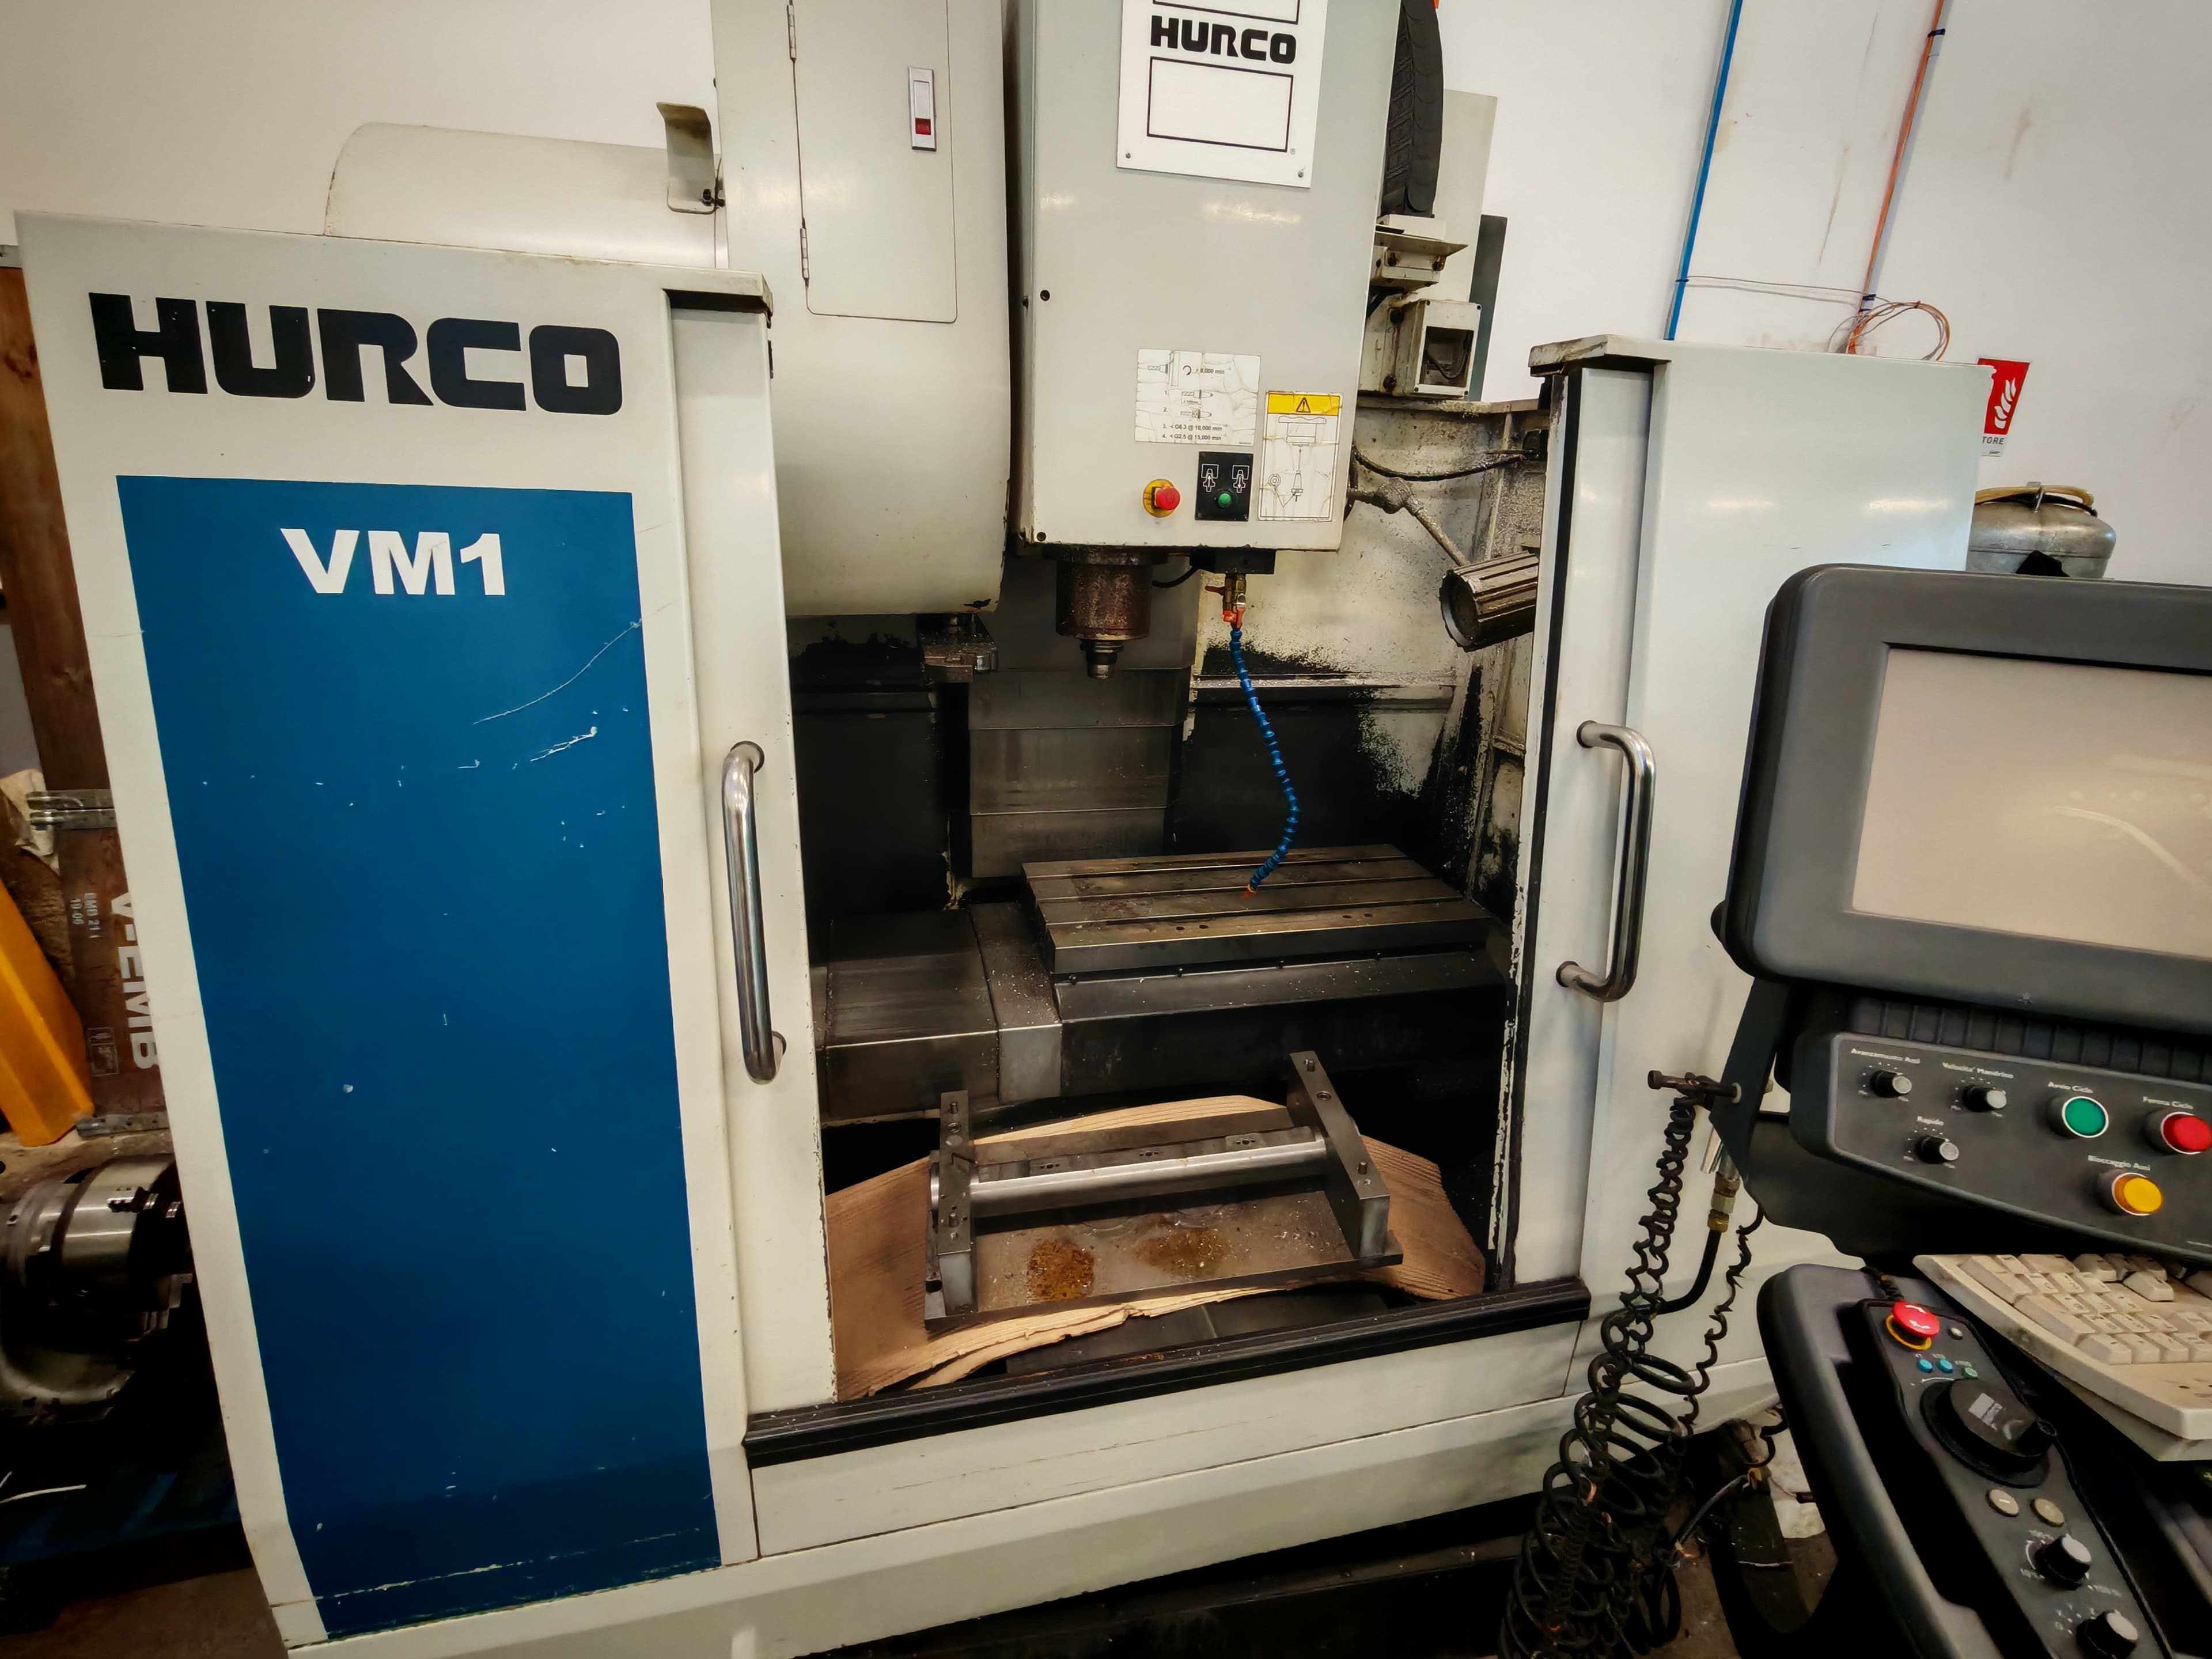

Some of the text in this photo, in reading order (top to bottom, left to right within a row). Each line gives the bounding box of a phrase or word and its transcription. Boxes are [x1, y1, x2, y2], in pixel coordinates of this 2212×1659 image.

[1150, 15, 1297, 65] HURCO
[88, 292, 623, 416] HURCO
[280, 528, 505, 597] VM1
